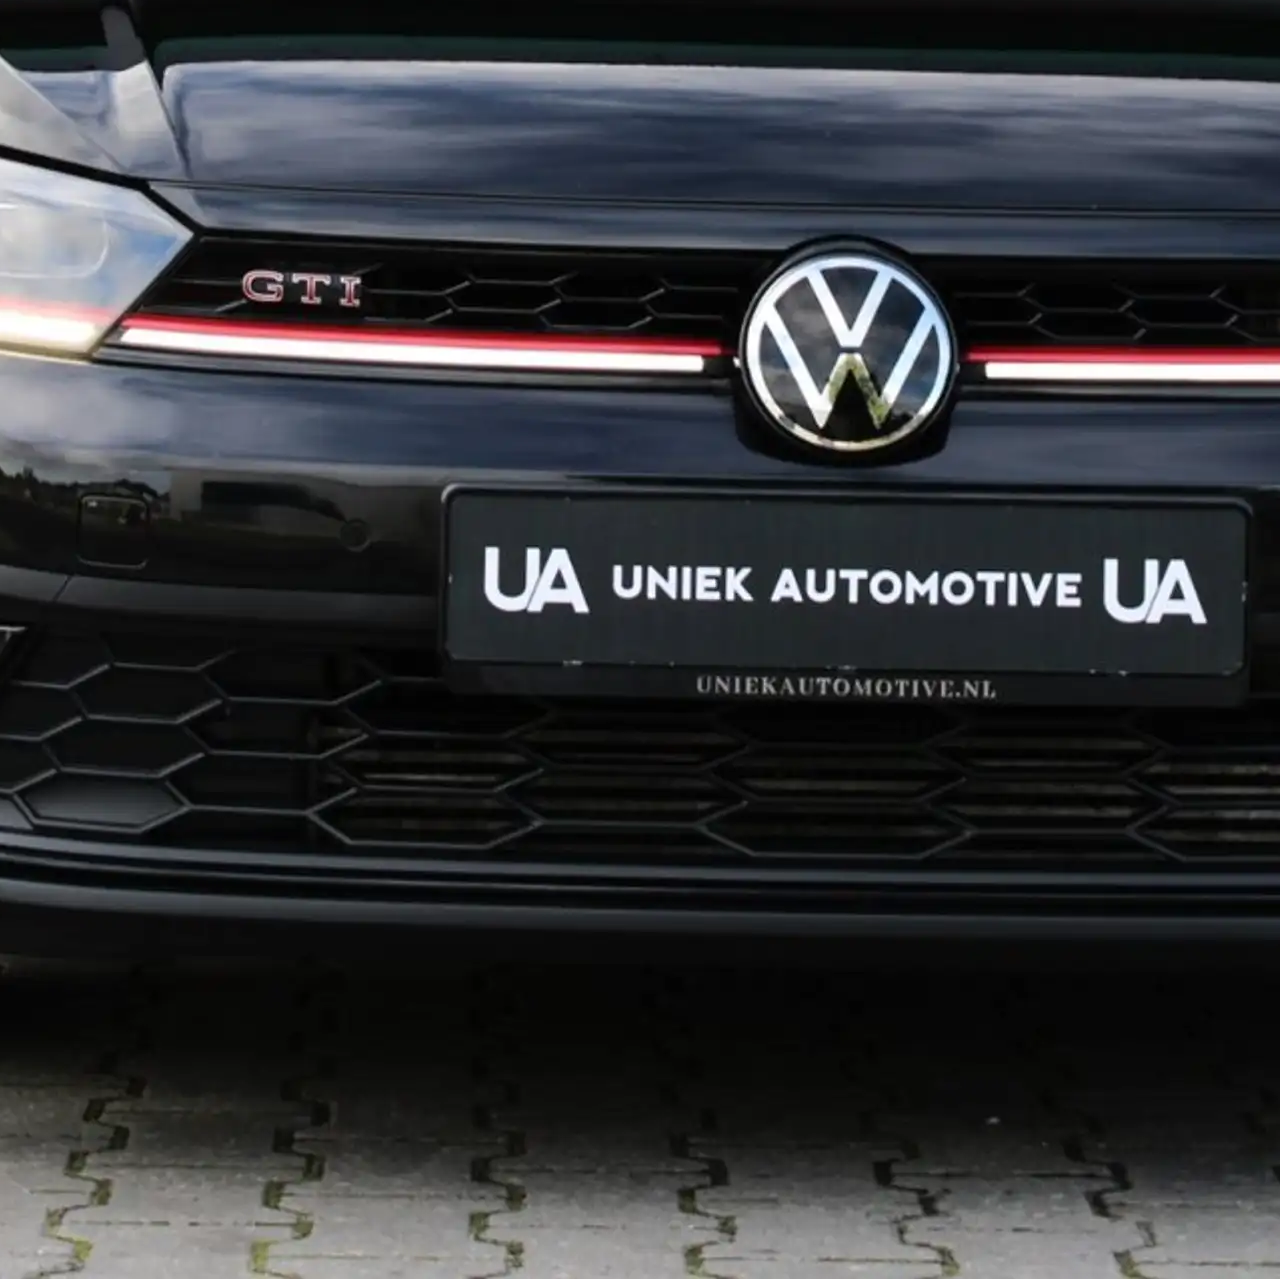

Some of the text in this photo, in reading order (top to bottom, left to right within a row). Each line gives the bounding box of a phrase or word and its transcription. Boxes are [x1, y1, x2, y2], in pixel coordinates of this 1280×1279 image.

[241, 269, 363, 308] GTI
[483, 545, 1208, 624] UA UNIEK AUTOMOTIVE UA
[695, 674, 998, 700] UNIEKAUTOMOTIVE.NL
